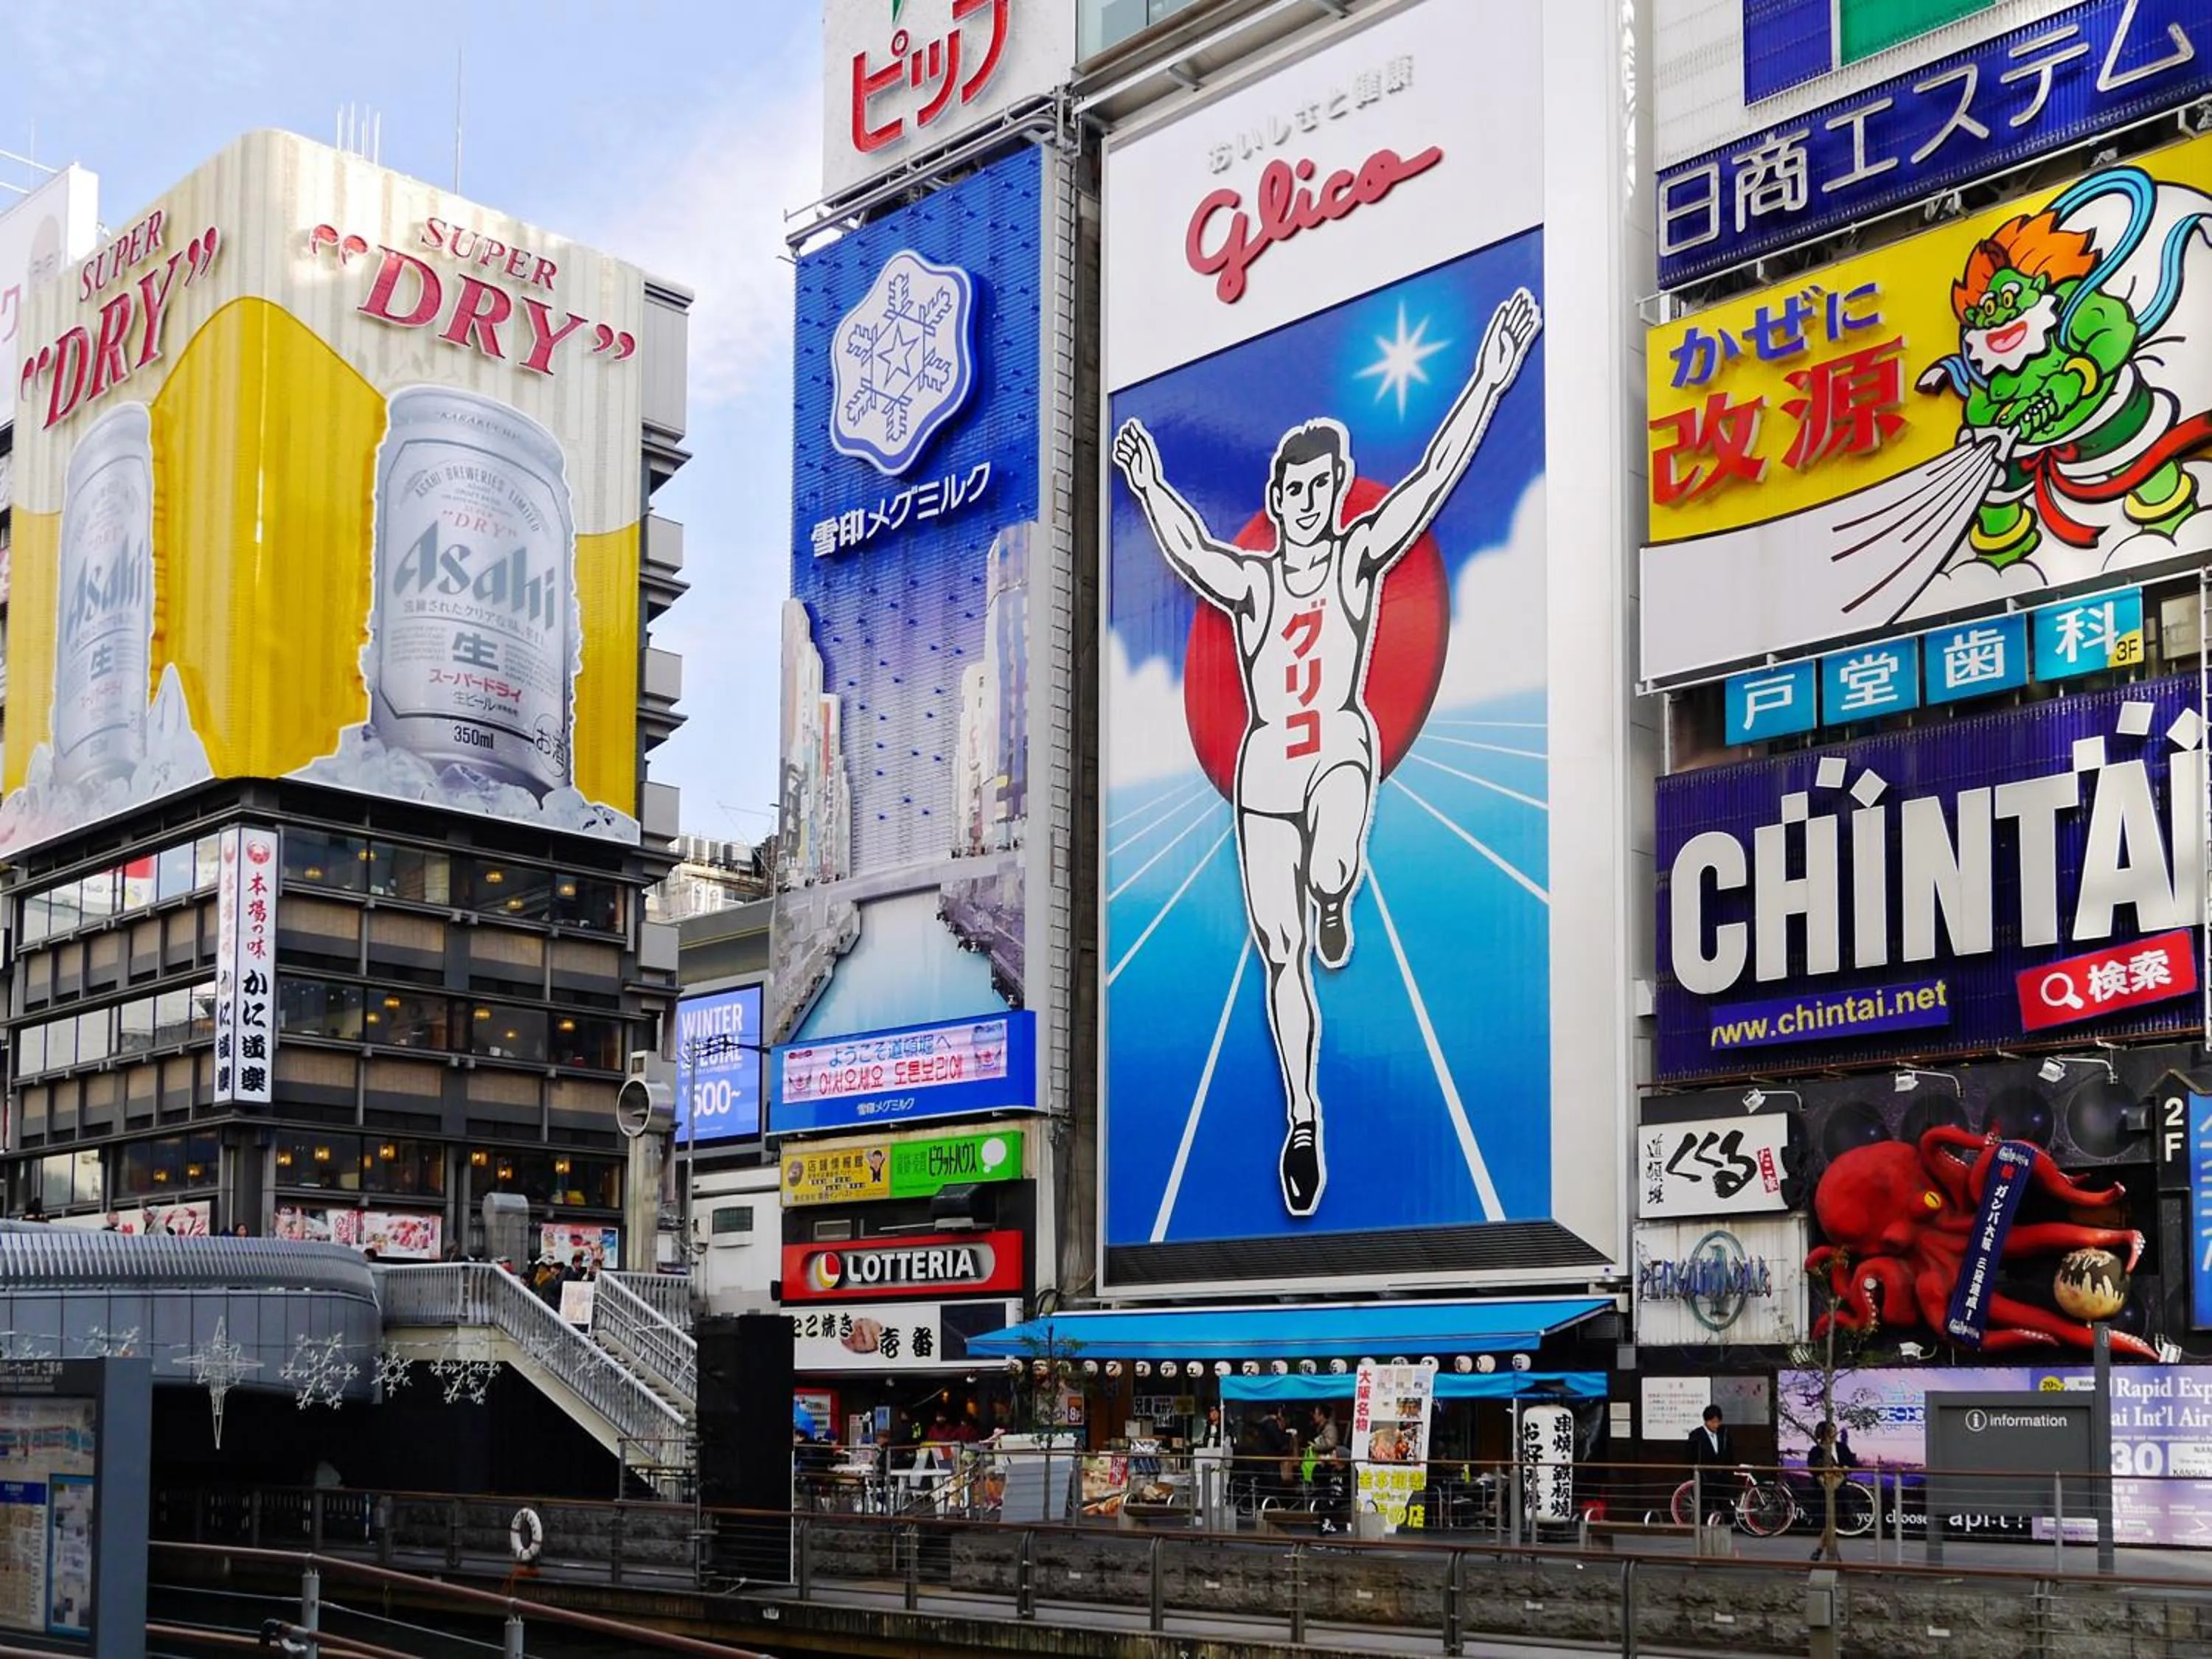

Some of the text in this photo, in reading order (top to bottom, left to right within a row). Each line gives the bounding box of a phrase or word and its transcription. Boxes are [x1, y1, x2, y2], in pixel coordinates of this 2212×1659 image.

[1207, 55, 1414, 174] おいしさと健康
[1658, 0, 2194, 257] 日商エステム
[79, 210, 166, 302] SUPER
[421, 217, 558, 291] SUPER
[1185, 147, 1444, 304] Glico
[1669, 282, 1886, 389] かぜに
[1649, 334, 1912, 509] 改源
[810, 462, 991, 559] 雪印メグミルク
[393, 520, 554, 630] Asahi
[452, 632, 499, 672] 生
[1281, 598, 1326, 760] グリコ
[2115, 639, 2137, 662] 3F
[429, 669, 522, 702] スーパードライ
[454, 726, 494, 750] 350ml
[247, 872, 268, 960] 本場の味
[2087, 949, 2171, 1004] 検索
[681, 1004, 742, 1040] WINTER
[830, 1034, 951, 1067] ようこそ道頓堀へ
[847, 1248, 975, 1282] LOTTERIA
[1355, 1370, 1371, 1432] 大阪名物
[1989, 1413, 2067, 1429] information
[2115, 1376, 2174, 1404] Rapid
